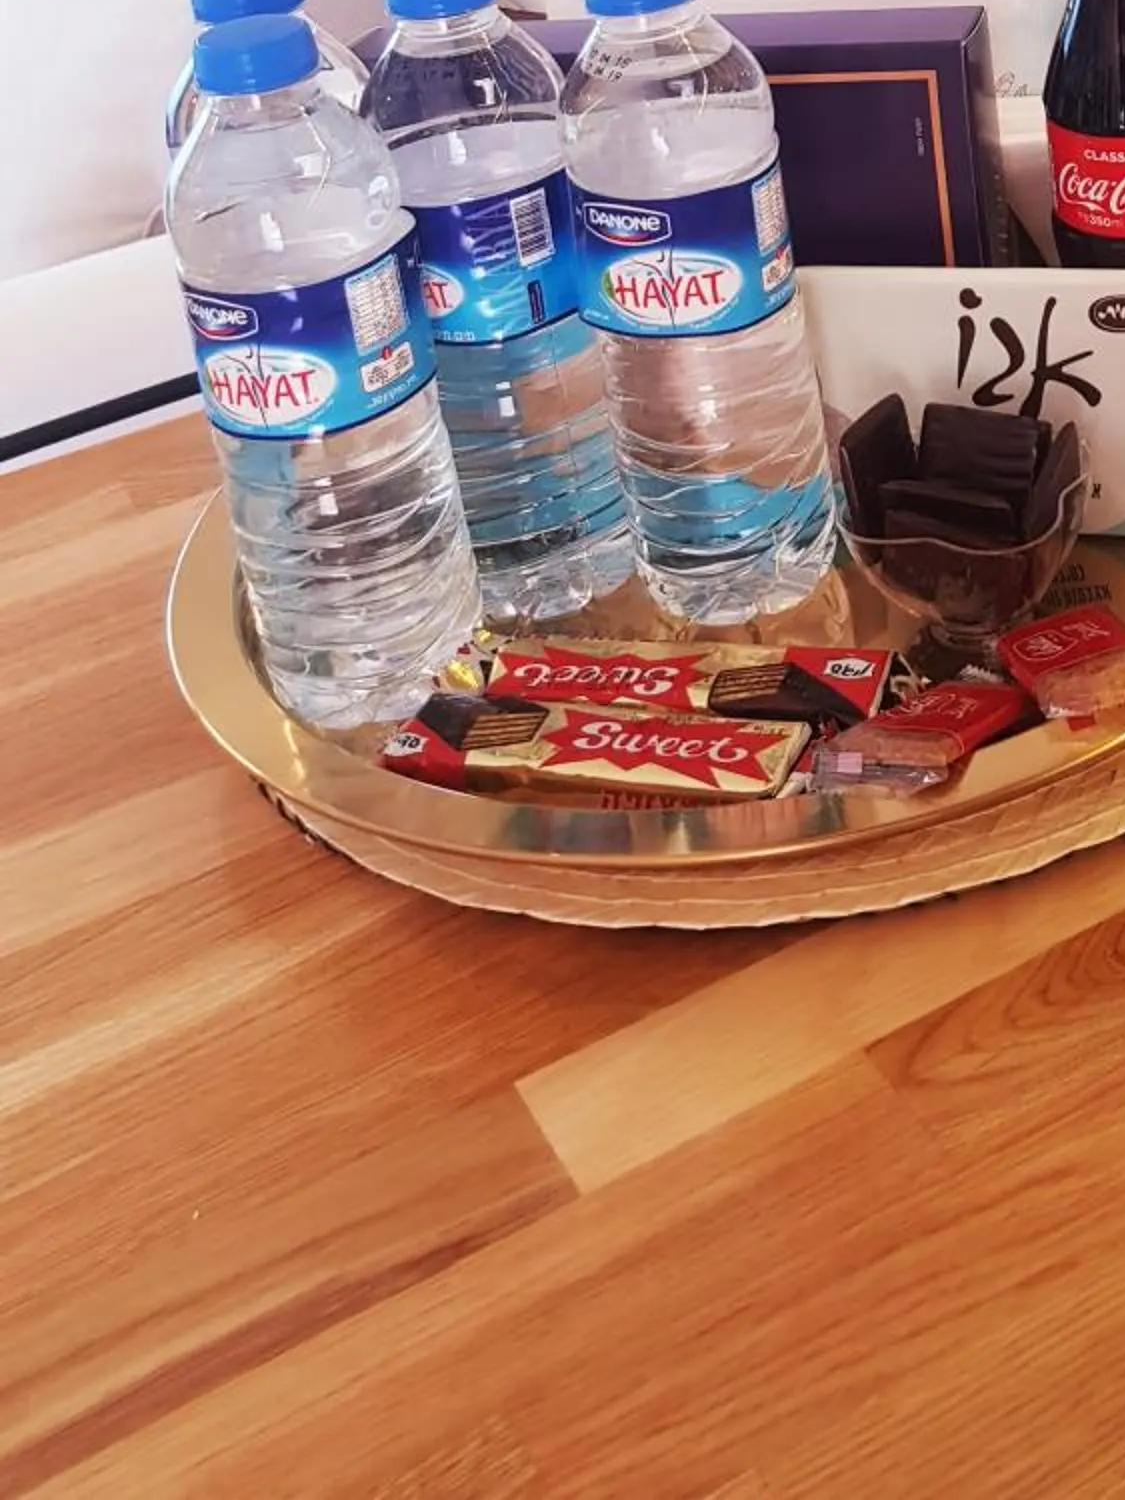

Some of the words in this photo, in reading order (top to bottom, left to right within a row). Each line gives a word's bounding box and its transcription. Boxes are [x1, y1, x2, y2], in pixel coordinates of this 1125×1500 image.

[608, 270, 725, 310] HAYAT
[212, 369, 316, 410] HAYAT
[513, 661, 681, 697] Sweet
[571, 721, 750, 764] Sweet
